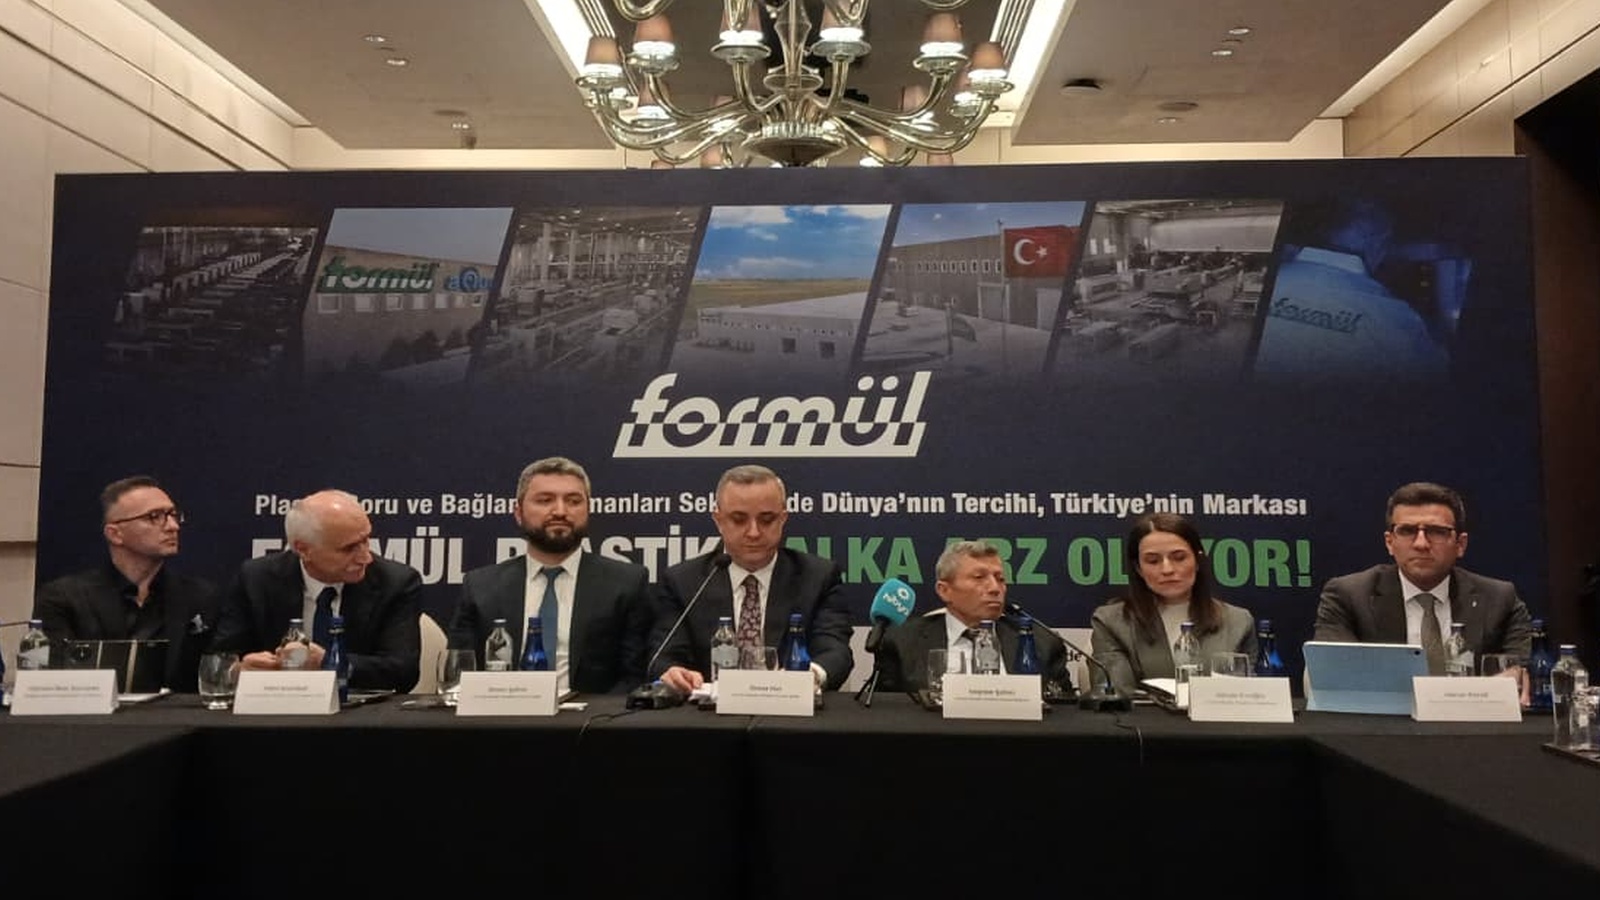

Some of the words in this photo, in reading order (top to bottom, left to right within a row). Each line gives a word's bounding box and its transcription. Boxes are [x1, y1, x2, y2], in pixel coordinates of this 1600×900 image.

[613, 371, 932, 457] formül
[354, 494, 398, 515] oru
[407, 499, 433, 515] ve
[822, 492, 946, 517] Dünya’nın
[952, 492, 1045, 518] Tercihi,
[1050, 492, 1194, 519] Türkiye’nin
[1203, 493, 1307, 515] Markası
[1067, 537, 1313, 587] OLOR!
